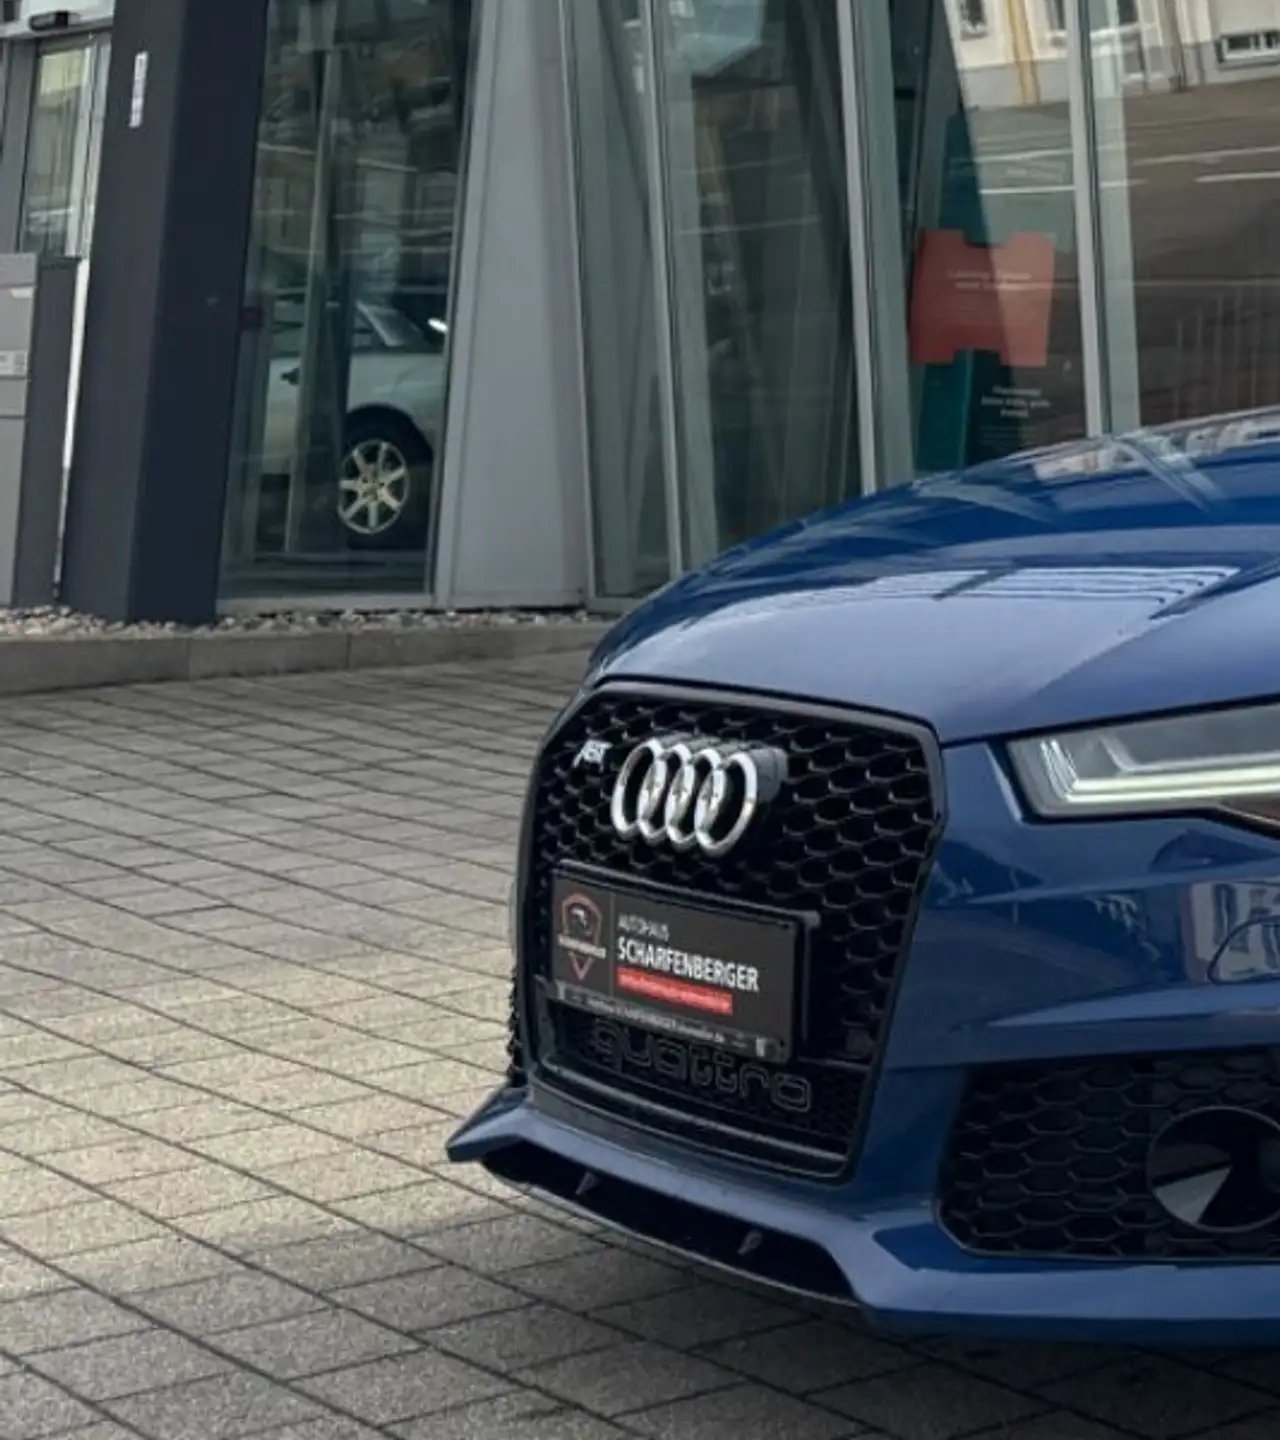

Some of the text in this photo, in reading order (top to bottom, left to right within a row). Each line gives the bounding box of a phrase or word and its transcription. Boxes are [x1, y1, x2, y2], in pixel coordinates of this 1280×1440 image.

[617, 913, 669, 942] AUTOHAUS
[617, 935, 760, 992] SCHARFENBERGER
[591, 1016, 812, 1113] quattro
